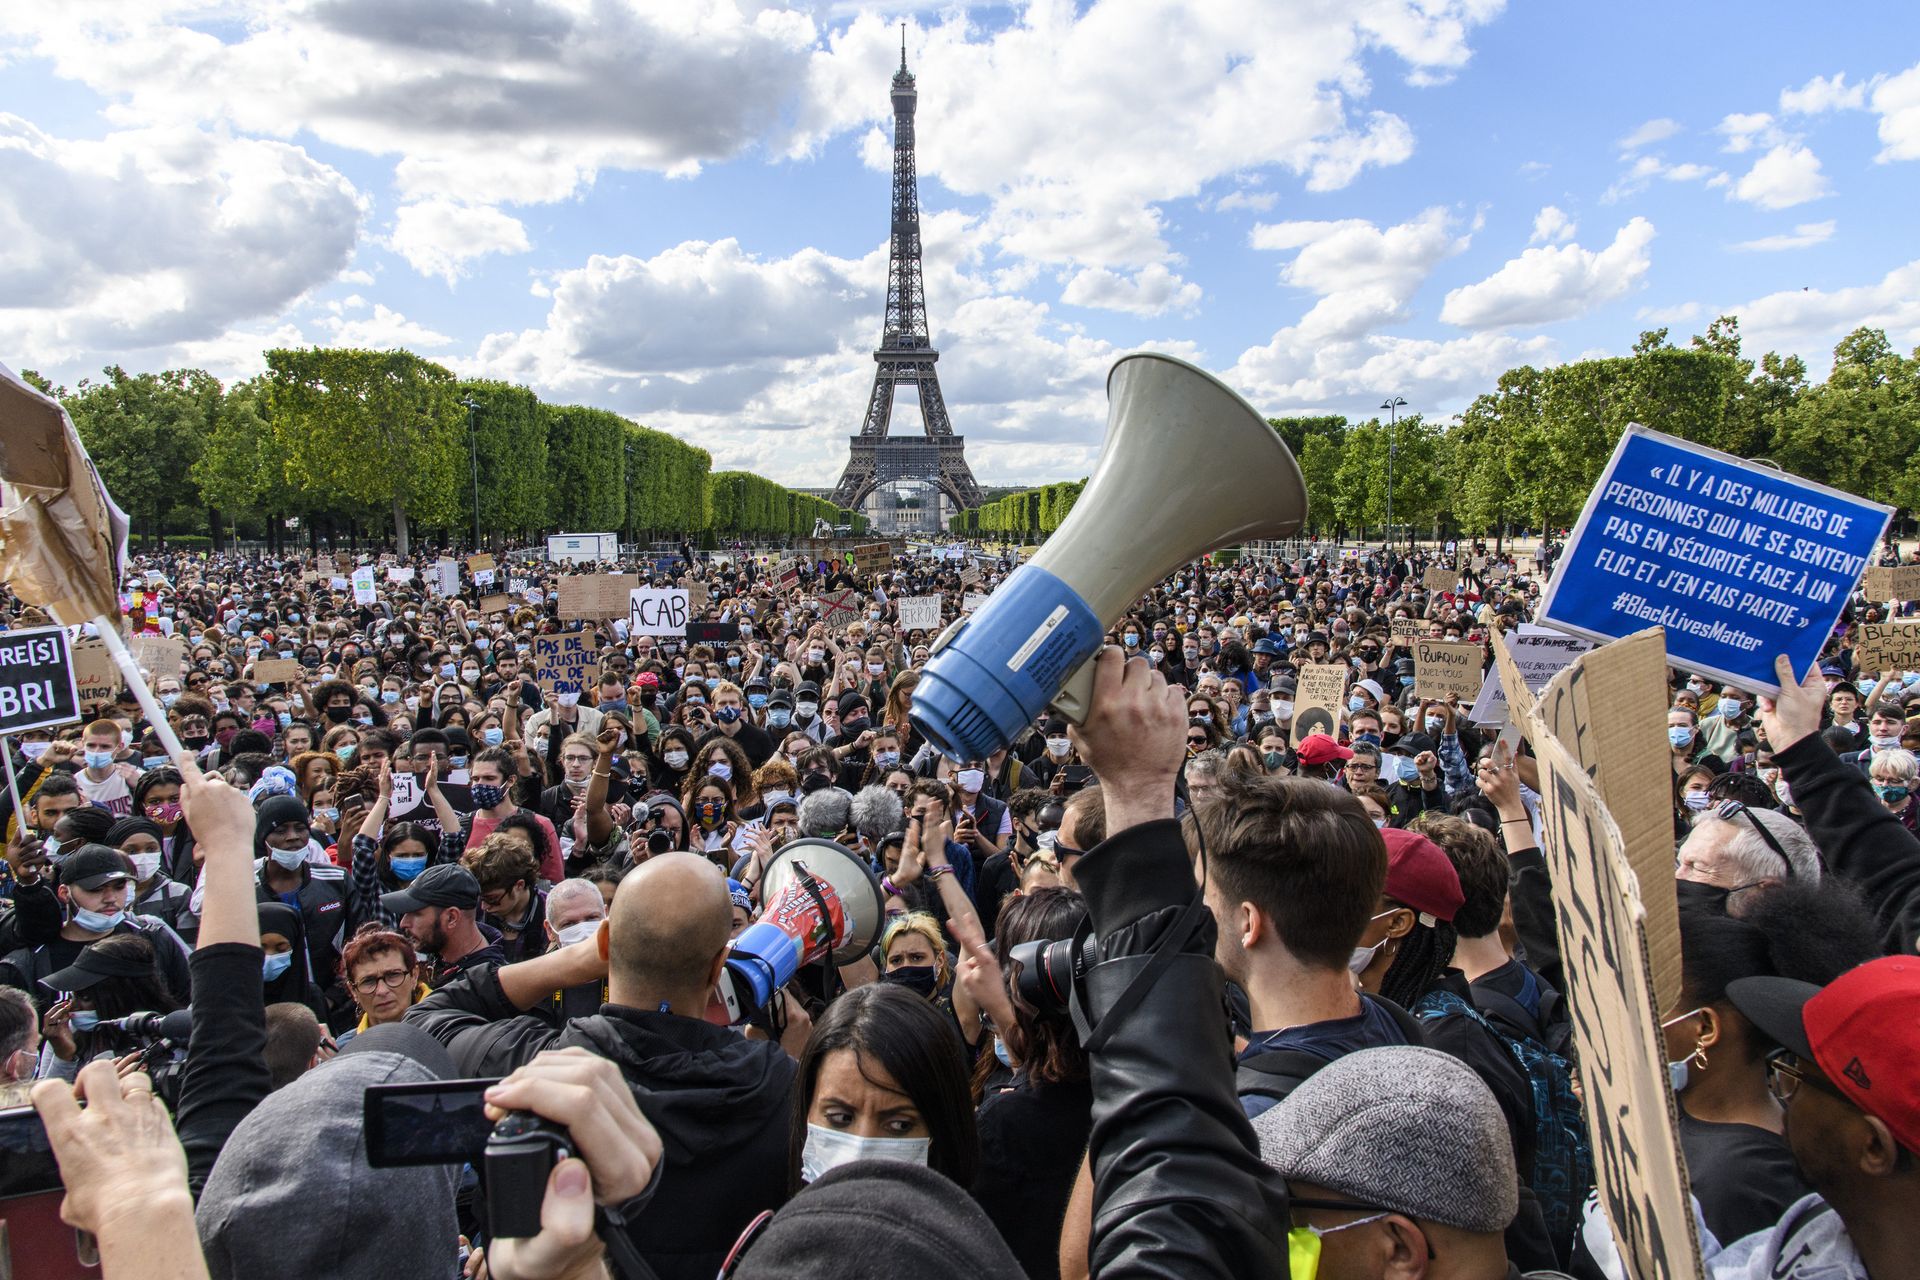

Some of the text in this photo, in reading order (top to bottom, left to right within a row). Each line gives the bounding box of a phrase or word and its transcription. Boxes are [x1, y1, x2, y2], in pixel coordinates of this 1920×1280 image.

[1665, 464, 1683, 487] IL
[1686, 469, 1703, 491] Y
[1699, 475, 1716, 497] A
[1715, 479, 1752, 507] DES
[1750, 490, 1828, 531] MILLIERS
[1825, 514, 1853, 539] DE
[1604, 480, 1866, 577] PERSONNES QUI NE SE SENTENT
[1603, 515, 1838, 604] PAS EN SÉCURITÉ FACE À UN
[1898, 567, 1920, 577] MAN
[1594, 548, 1636, 577] FLIC
[1633, 560, 1661, 585] ET
[1698, 581, 1739, 610] FAIS
[1737, 592, 1800, 628] PARTIE
[900, 597, 918, 606] END
[631, 594, 686, 628] ACAB
[900, 606, 938, 625] TERROR
[1611, 591, 1764, 652] #BlackLivesMatter
[1392, 627, 1430, 637] SILENCE
[1864, 624, 1920, 640] BLACK
[0, 637, 60, 667] RE[S]
[536, 636, 583, 655] PAS DE
[699, 640, 729, 648] JUSTICE
[545, 650, 597, 668] JUSTICE
[1515, 661, 1533, 669] LICE
[1878, 651, 1920, 664] HUMA
[537, 666, 584, 680] PAS DE
[78, 687, 111, 700] NERGY
[553, 680, 584, 694] PAIX
[320, 902, 340, 911] adidas
